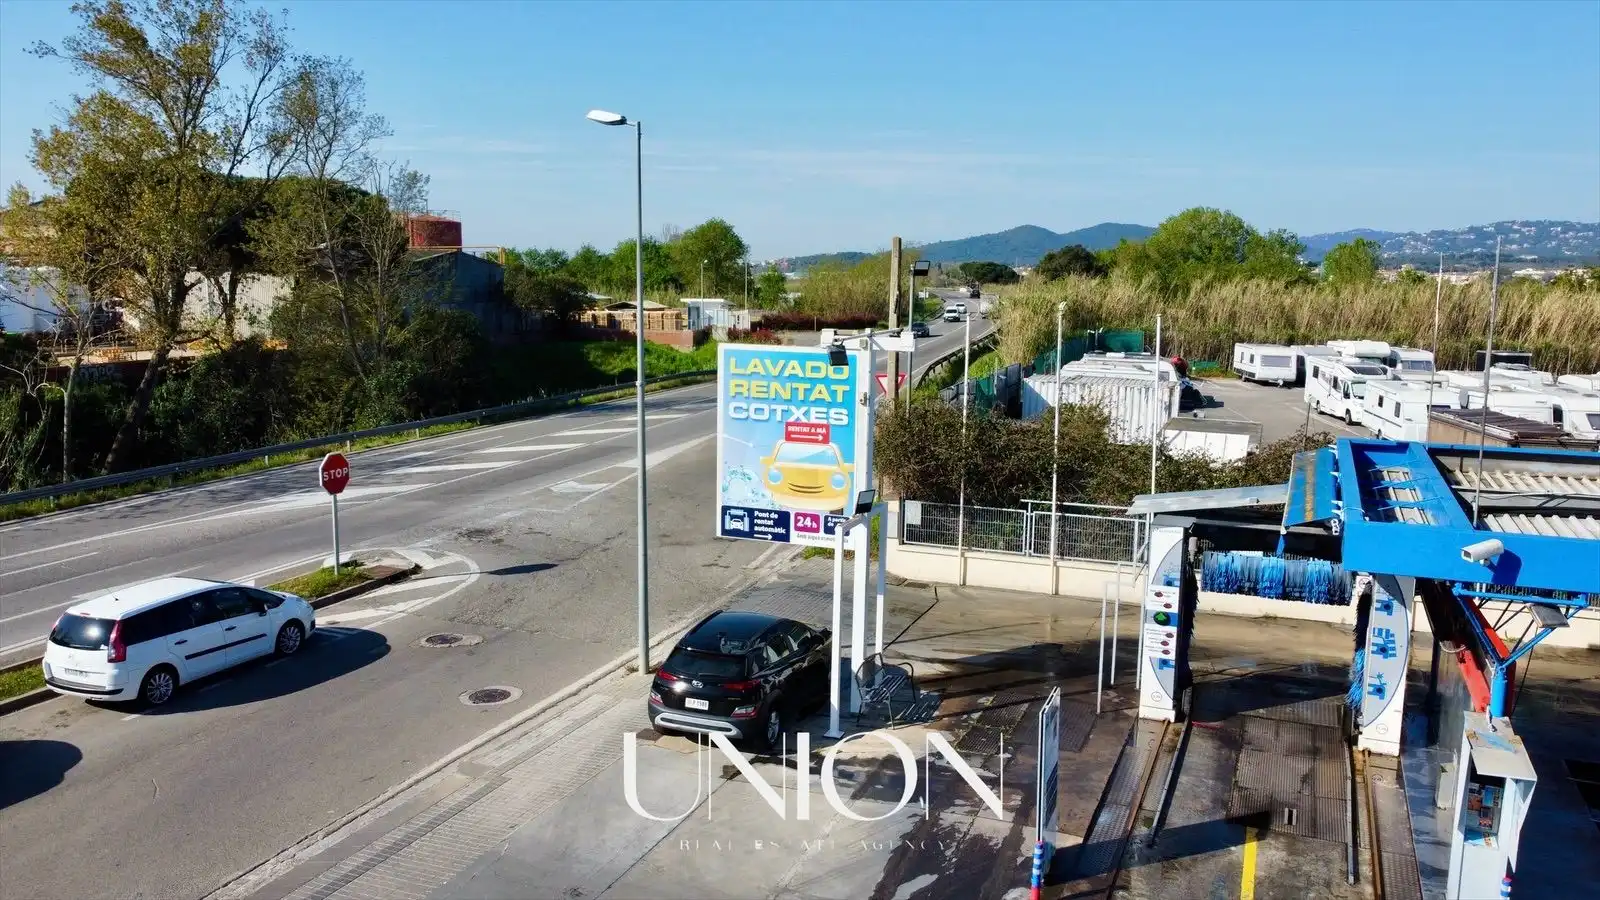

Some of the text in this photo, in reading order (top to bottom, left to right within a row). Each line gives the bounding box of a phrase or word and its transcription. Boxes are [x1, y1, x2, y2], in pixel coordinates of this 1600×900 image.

[730, 356, 849, 379] LAVADO
[729, 379, 850, 403] RENTAT
[728, 402, 849, 426] COTXES
[323, 467, 348, 481] STOP
[754, 510, 769, 518] Pont
